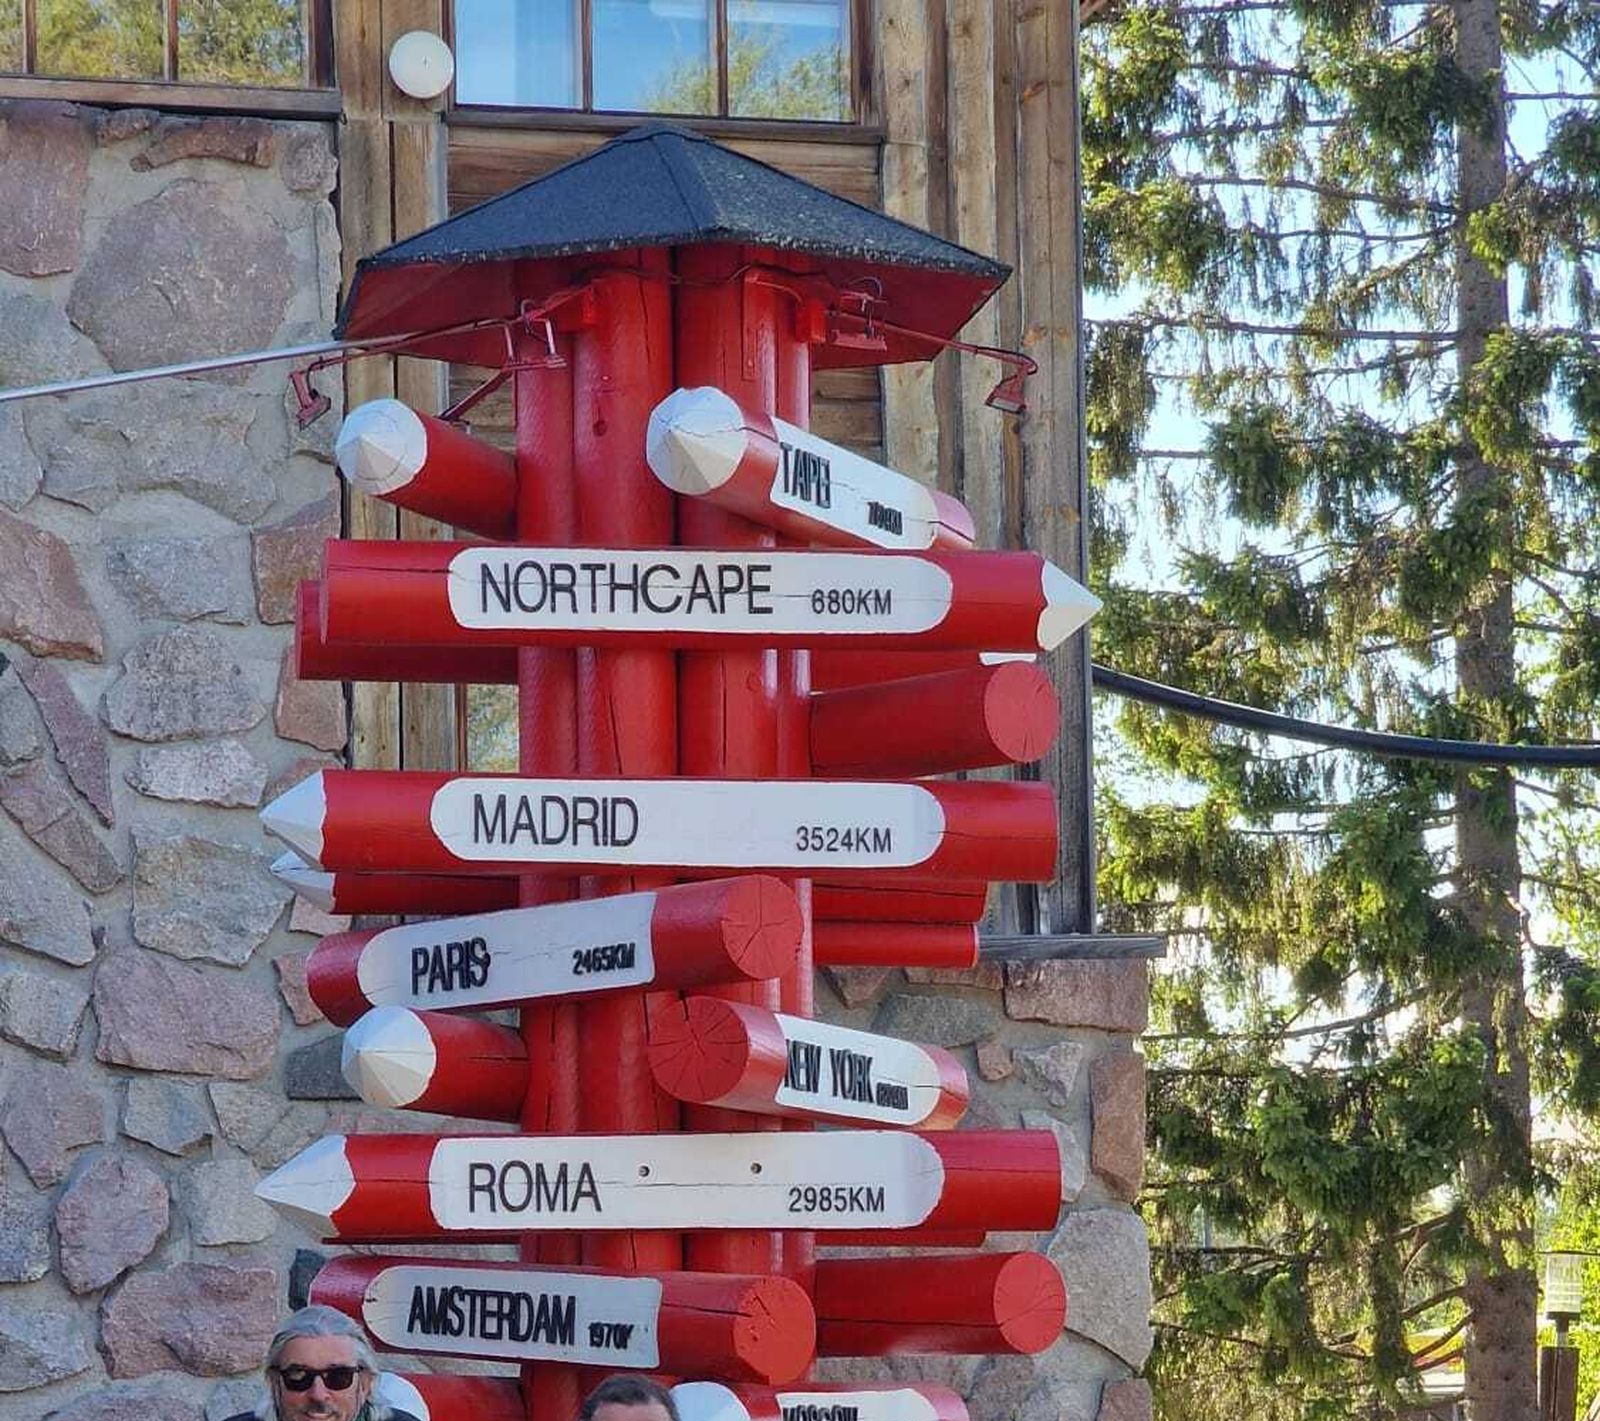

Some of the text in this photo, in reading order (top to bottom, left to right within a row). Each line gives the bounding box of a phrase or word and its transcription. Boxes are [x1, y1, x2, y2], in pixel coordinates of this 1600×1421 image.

[780, 441, 832, 509] TAIPEI
[480, 560, 892, 616] NORTHCAPE 680KM
[473, 793, 892, 854] MADRID 3524KM
[411, 936, 636, 996] PARIS 2465KM
[784, 1038, 822, 1094] NEW
[829, 1047, 876, 1103] YORK
[468, 1160, 886, 1213] ROMA 2985KM
[407, 1285, 577, 1346] AMSTERDAM
